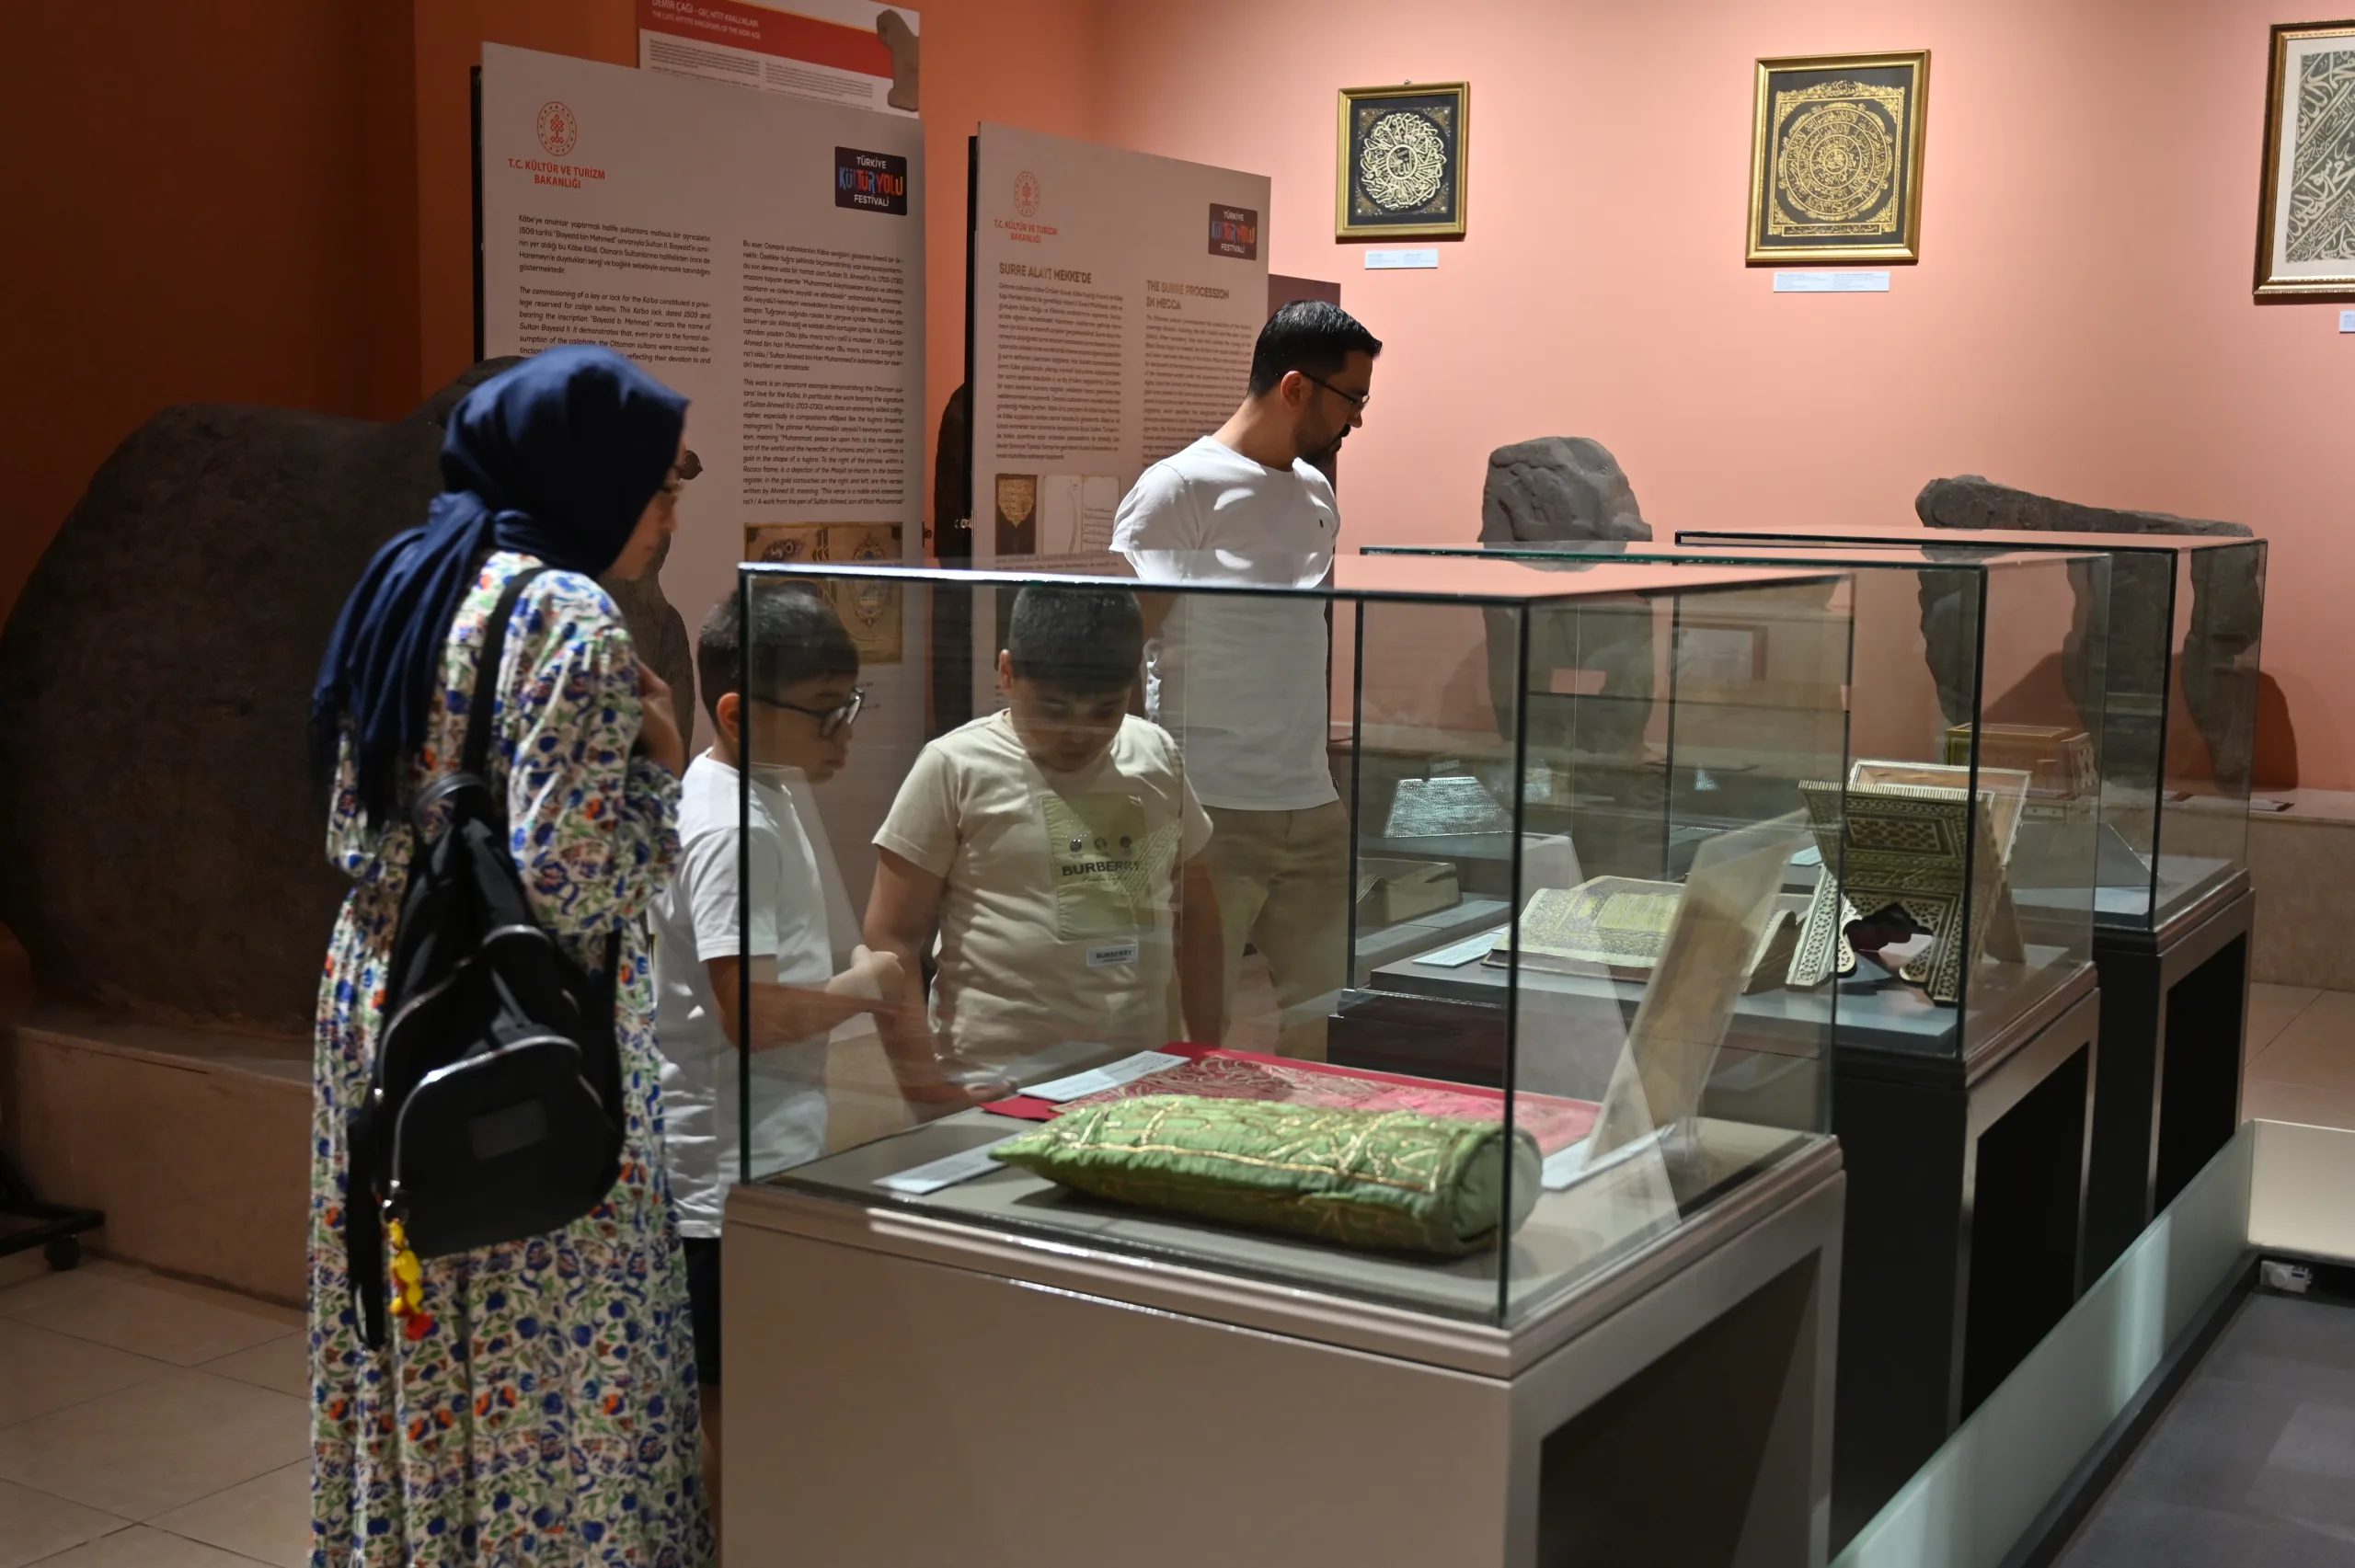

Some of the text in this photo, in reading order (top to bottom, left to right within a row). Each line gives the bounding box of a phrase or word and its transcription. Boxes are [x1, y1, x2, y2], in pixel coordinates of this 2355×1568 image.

[652, 10, 661, 18] THE
[508, 158, 605, 179] T.C. KÜLTÜR VE TURİZM
[856, 155, 887, 169] TÜRKİYE
[534, 174, 580, 189] BAKANLIĞI
[839, 166, 903, 196] KÜLTÜR YOLU
[854, 194, 889, 206] FESTİVALİ
[1005, 220, 1027, 231] KÜLTÜR
[1028, 224, 1035, 233] VE
[999, 262, 1092, 283] SURRE ALAYI MEKKE'DE
[1147, 280, 1229, 300] THE SURRE PROCESSION
[1146, 296, 1181, 310] IN MECCA
